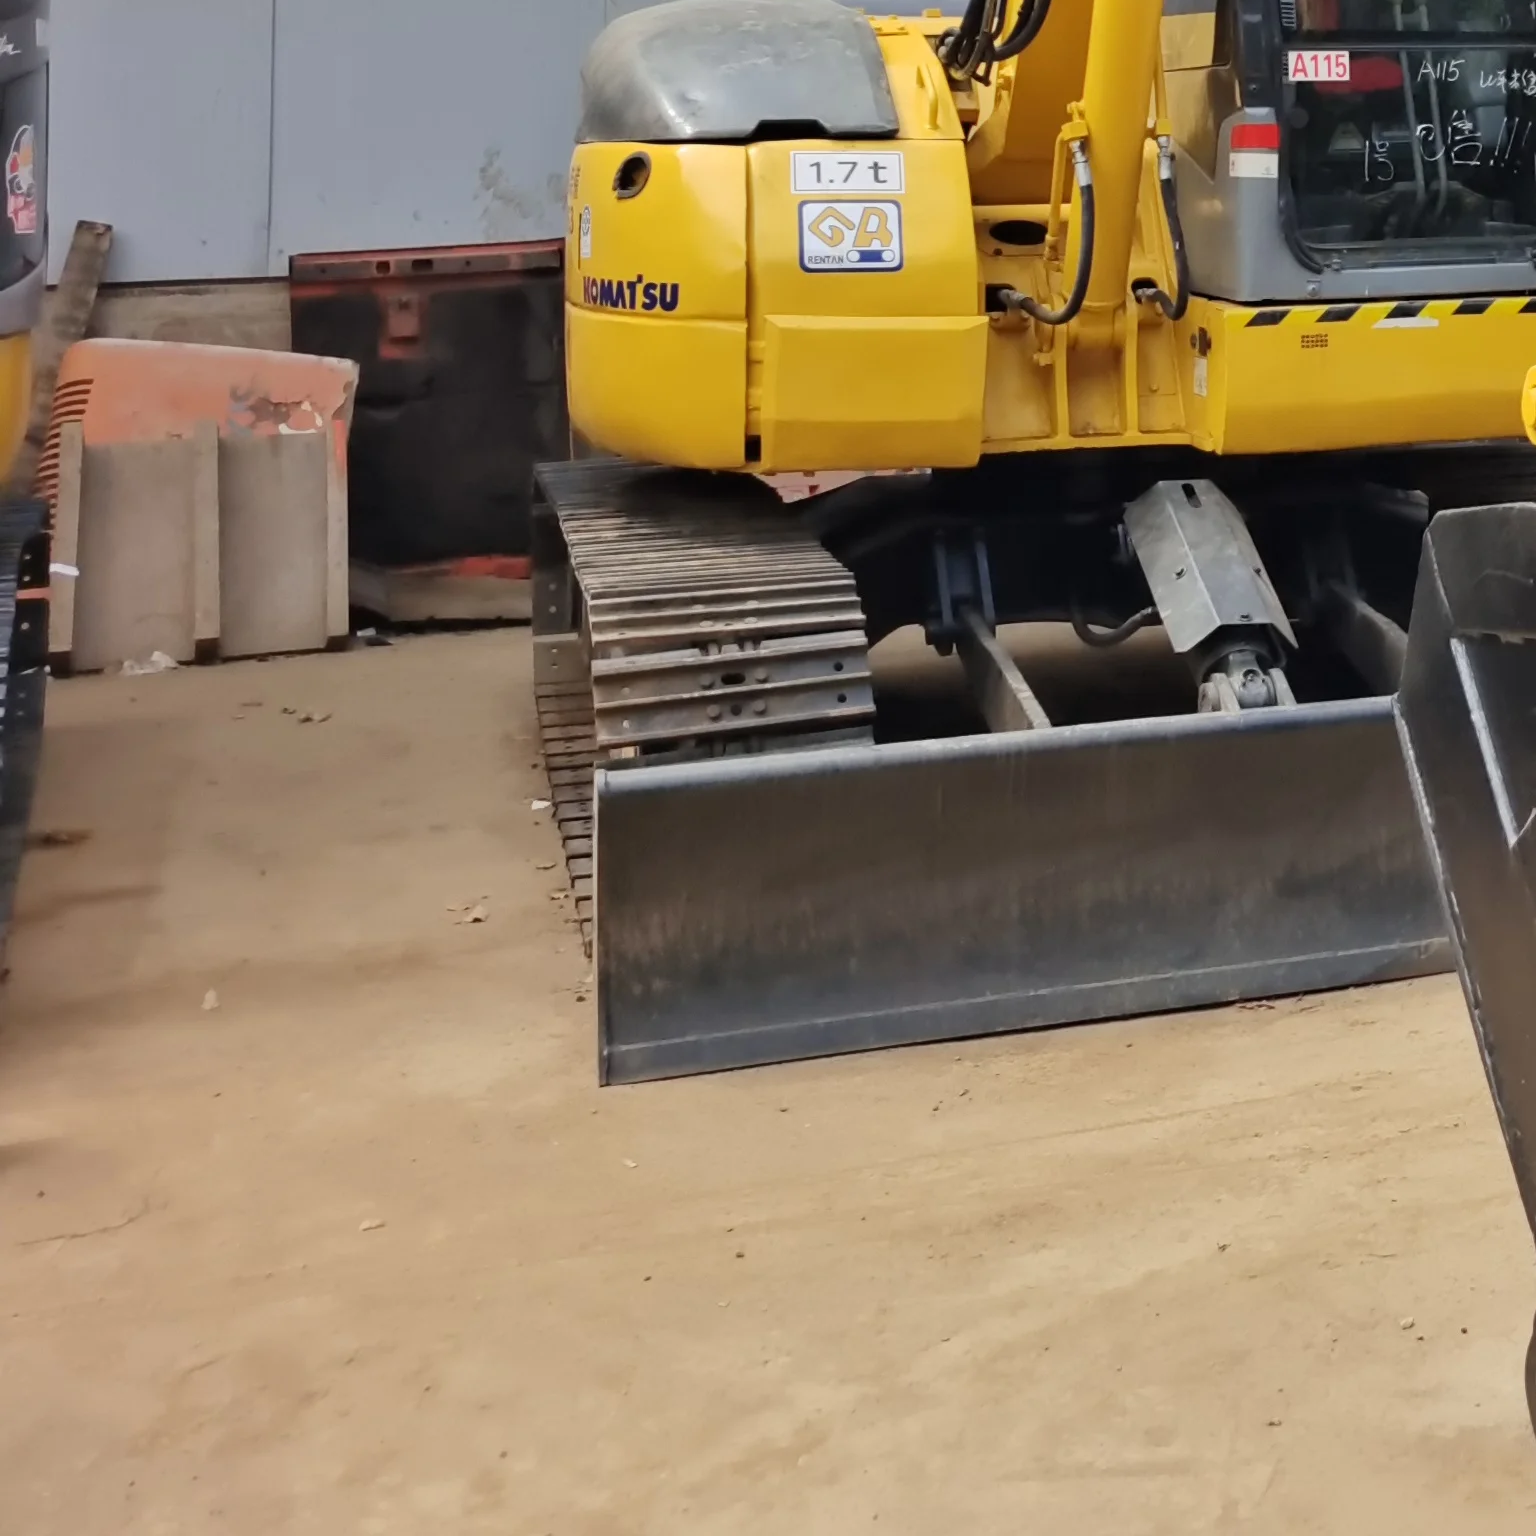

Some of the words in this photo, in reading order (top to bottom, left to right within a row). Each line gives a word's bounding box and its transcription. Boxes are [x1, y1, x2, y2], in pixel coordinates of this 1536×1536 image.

[1292, 52, 1347, 78] A115
[1417, 60, 1465, 82] A115
[583, 273, 679, 312] KOMATSU
